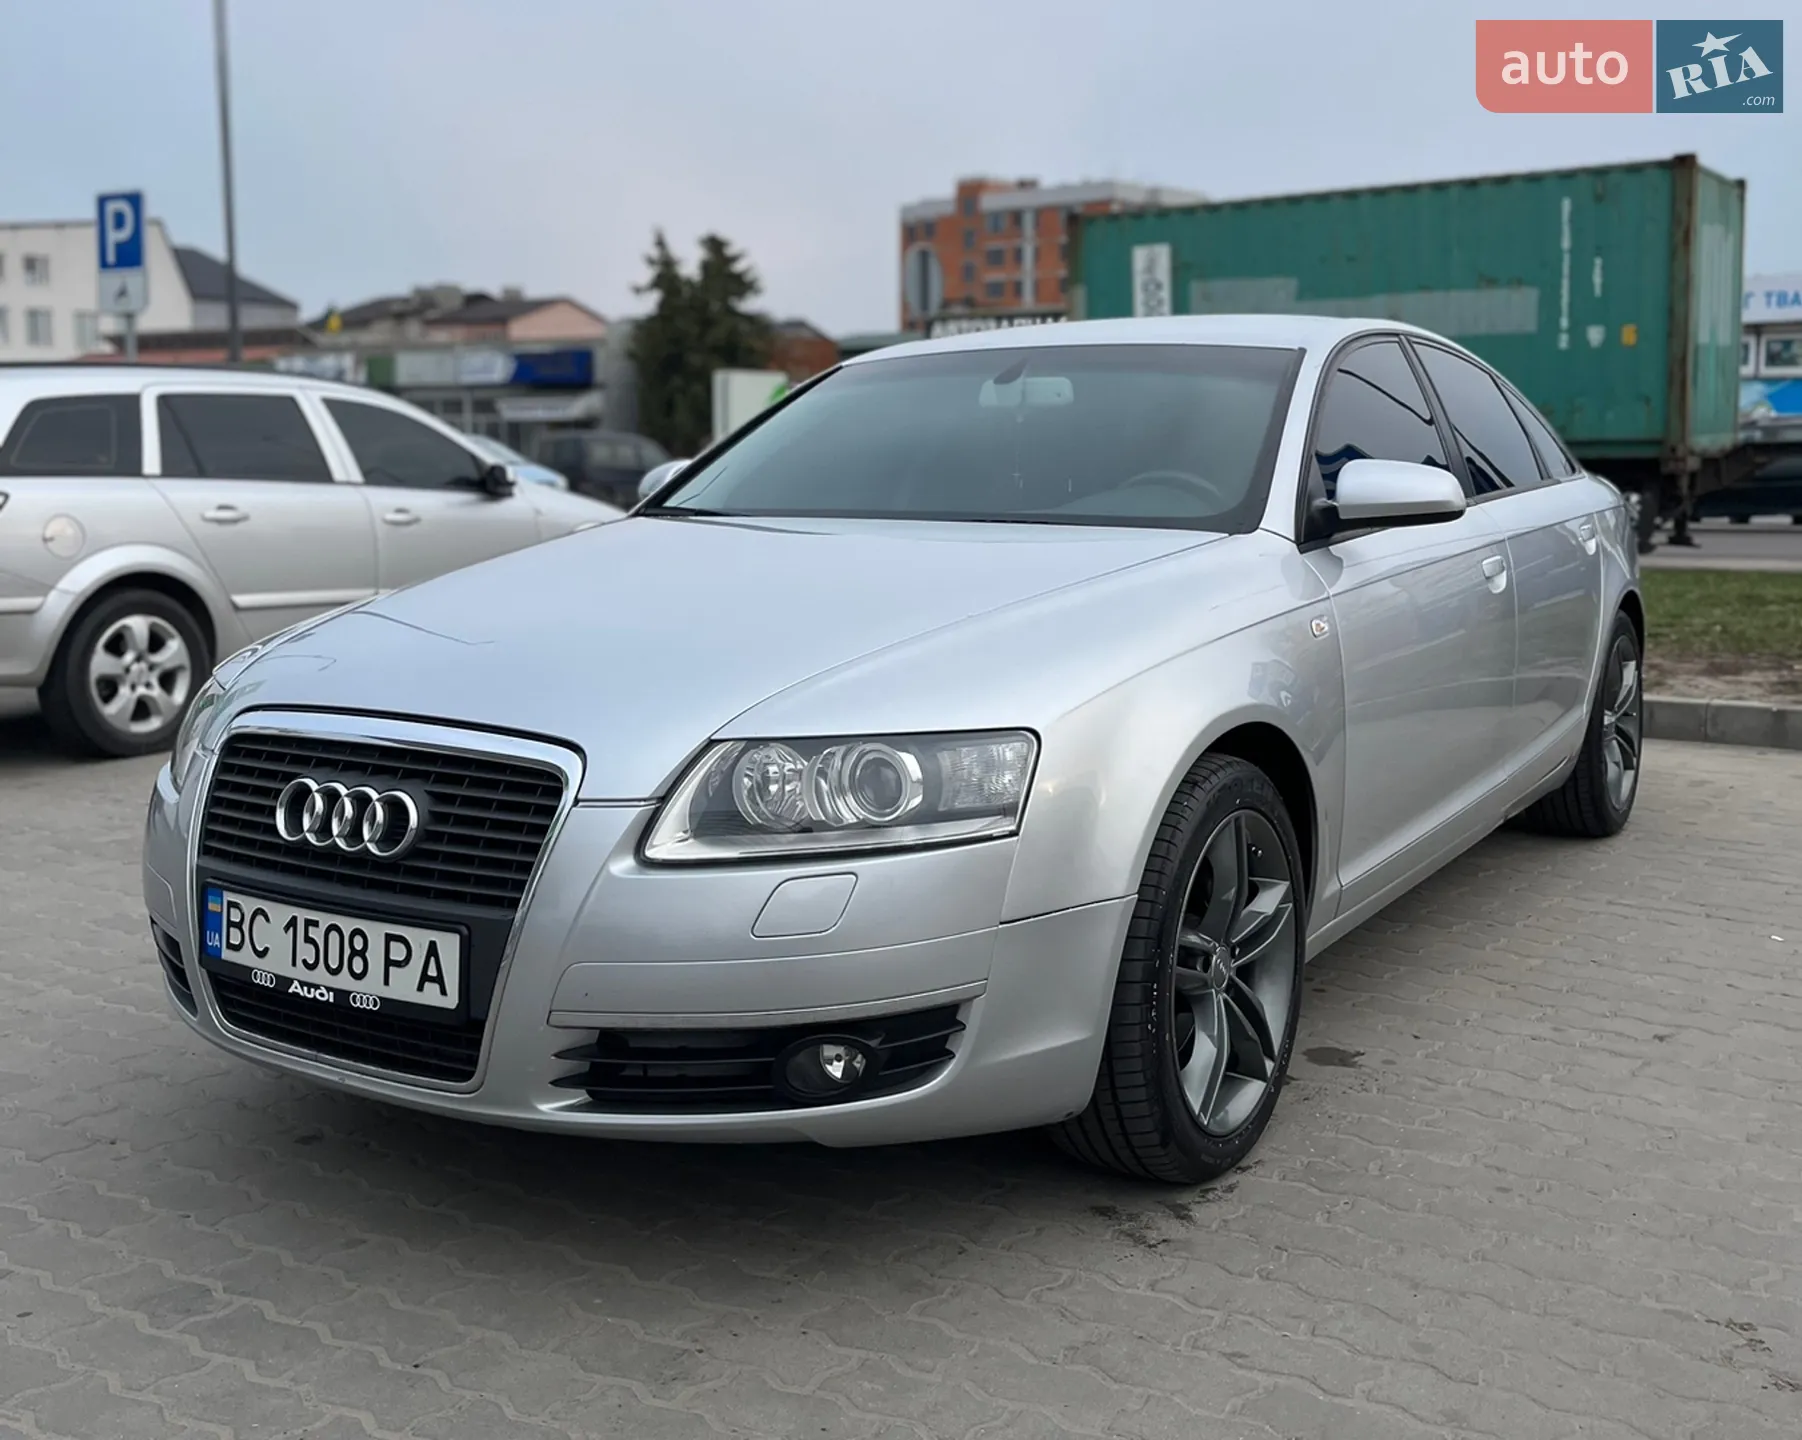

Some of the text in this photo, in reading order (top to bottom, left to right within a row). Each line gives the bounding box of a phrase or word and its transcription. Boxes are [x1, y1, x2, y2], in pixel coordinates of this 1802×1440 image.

[104, 199, 136, 266] P
[206, 930, 221, 948] UA
[226, 899, 448, 997] BC 1508 PA
[288, 979, 335, 1003] Audi
